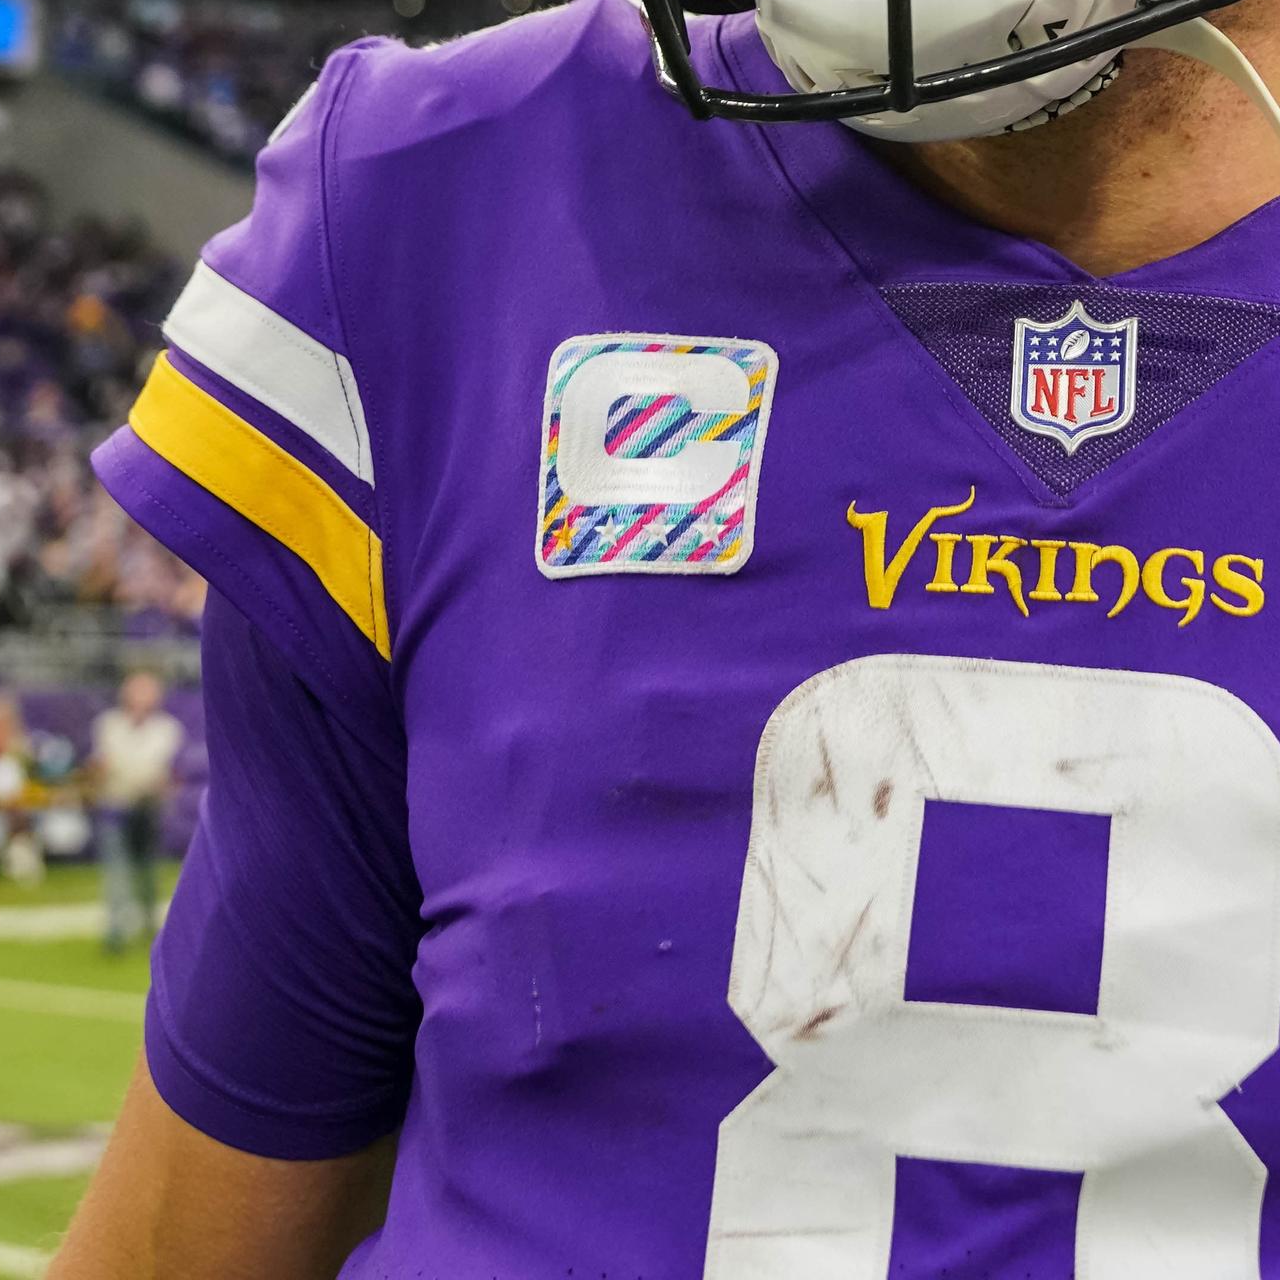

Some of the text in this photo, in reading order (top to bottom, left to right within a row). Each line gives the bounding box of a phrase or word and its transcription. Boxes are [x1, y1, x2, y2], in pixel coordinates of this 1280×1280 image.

[556, 351, 751, 505] C
[1031, 368, 1115, 424] NFL
[847, 485, 1265, 628] VIKINGS
